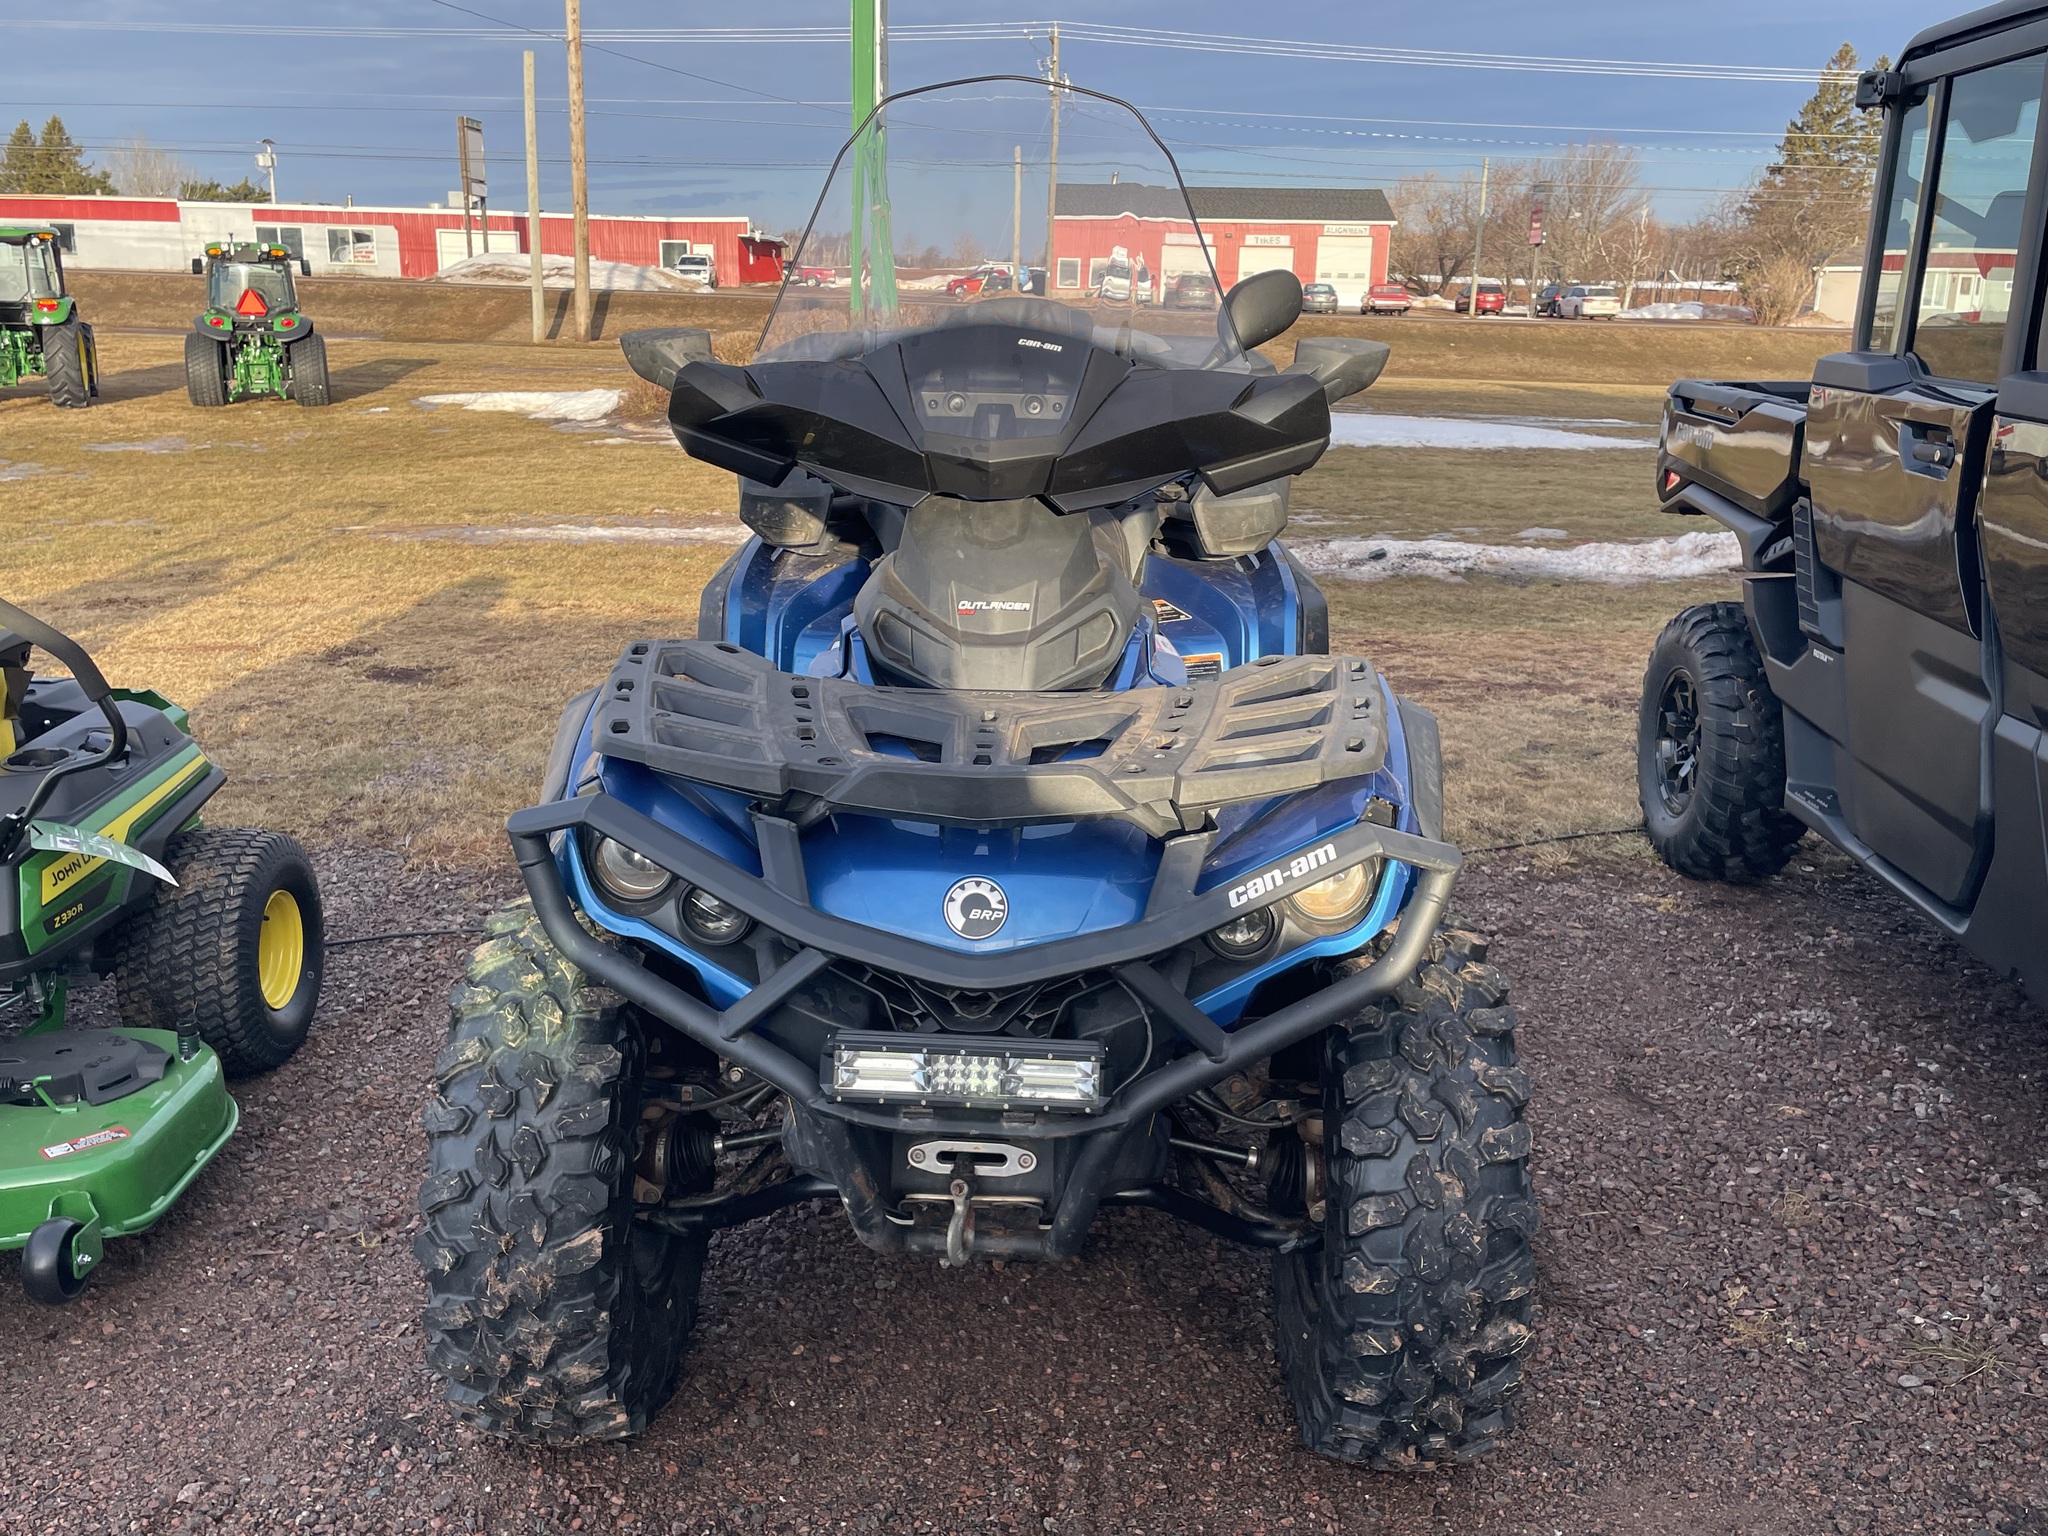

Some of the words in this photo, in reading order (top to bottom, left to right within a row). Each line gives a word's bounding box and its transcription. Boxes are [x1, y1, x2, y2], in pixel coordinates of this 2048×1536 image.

[1325, 227, 1368, 235] ALIGNMENT
[1254, 236, 1281, 245] TIRES
[1018, 338, 1063, 352] can-am
[958, 600, 1031, 611] OUTLANDER
[52, 857, 82, 887] JOHN
[1227, 843, 1338, 909] can-am
[53, 903, 84, 929] Z330R
[968, 908, 1004, 921] BRP
